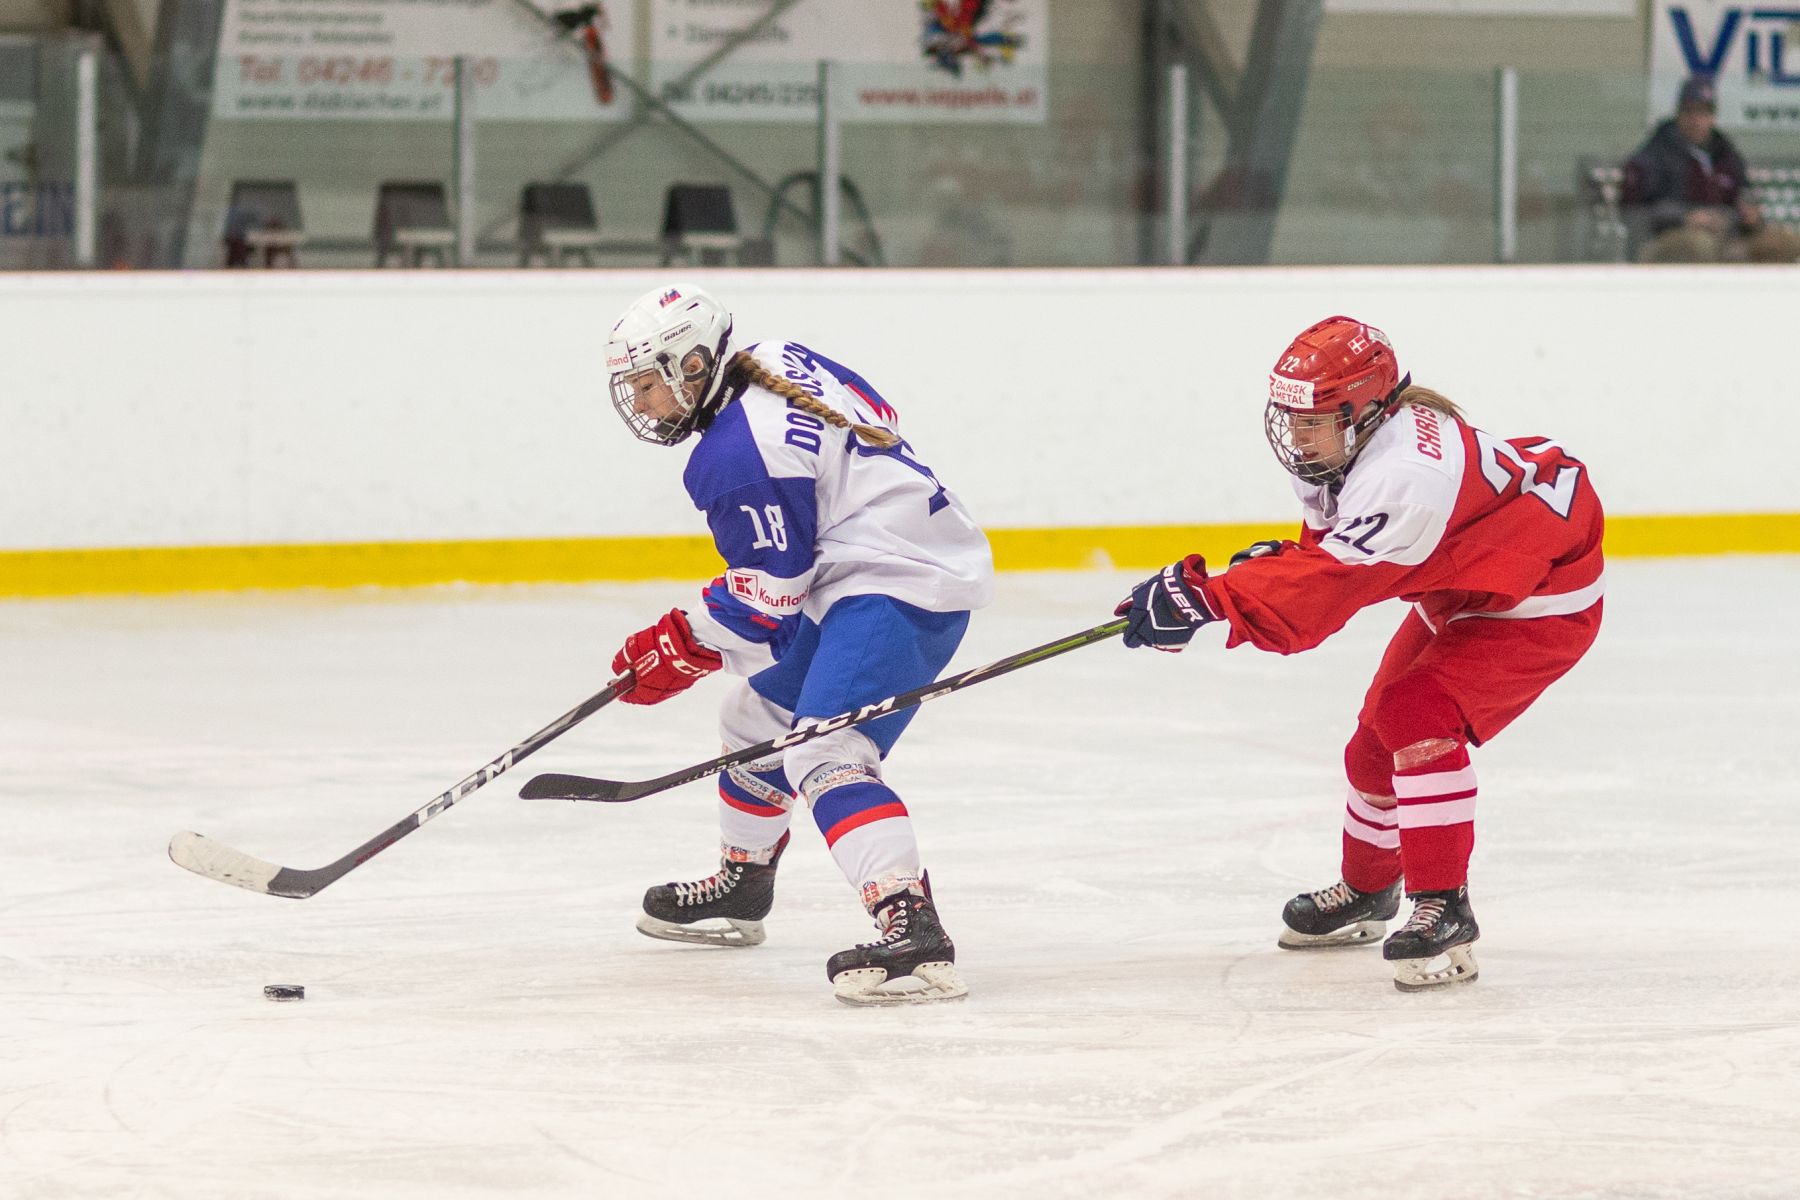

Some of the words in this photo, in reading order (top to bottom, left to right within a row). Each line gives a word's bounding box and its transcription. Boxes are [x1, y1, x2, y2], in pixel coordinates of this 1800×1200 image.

[1280, 355, 1300, 373] 22
[1275, 390, 1306, 405] METAL
[1276, 380, 1307, 396] DANSK
[739, 504, 788, 551] 18
[771, 696, 896, 749] CCM
[418, 750, 513, 826] CCM
